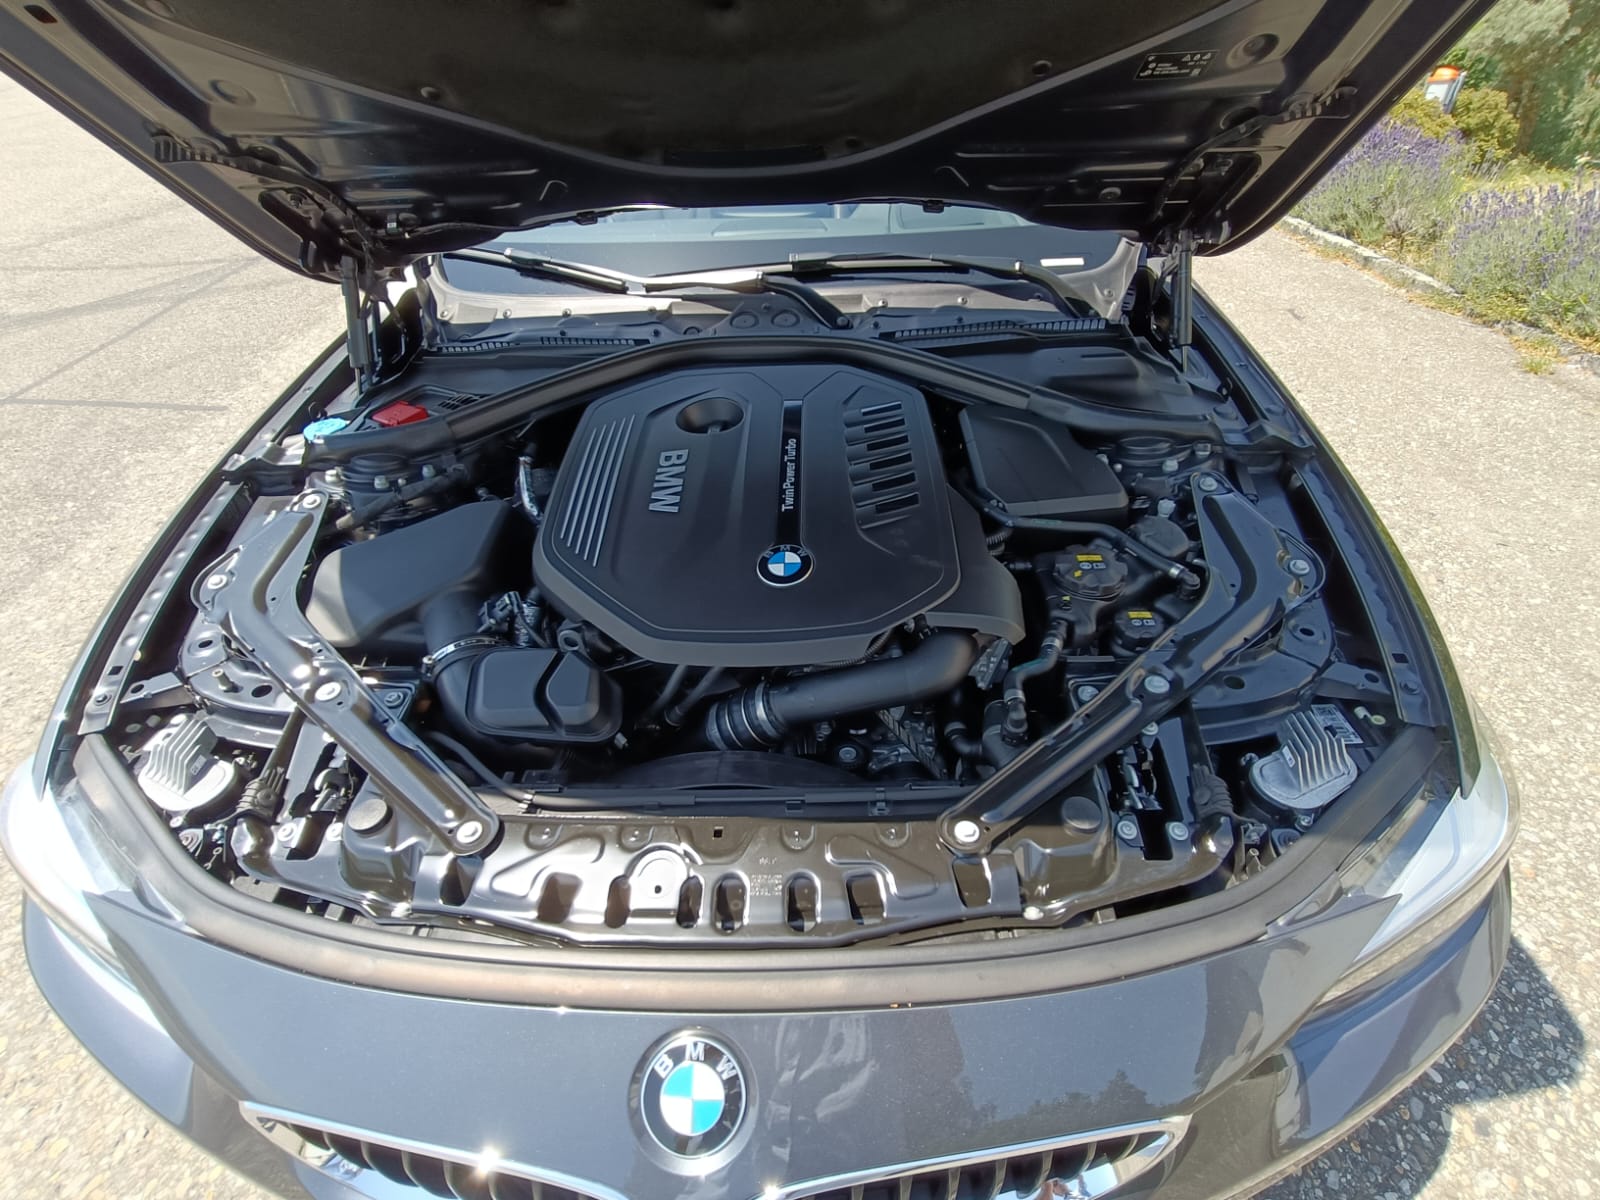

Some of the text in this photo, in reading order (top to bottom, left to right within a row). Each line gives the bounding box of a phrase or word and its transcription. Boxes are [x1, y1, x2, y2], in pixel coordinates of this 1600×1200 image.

[648, 449, 689, 513] BMW
[763, 544, 808, 558] BMW
[653, 1041, 737, 1081] BMW
